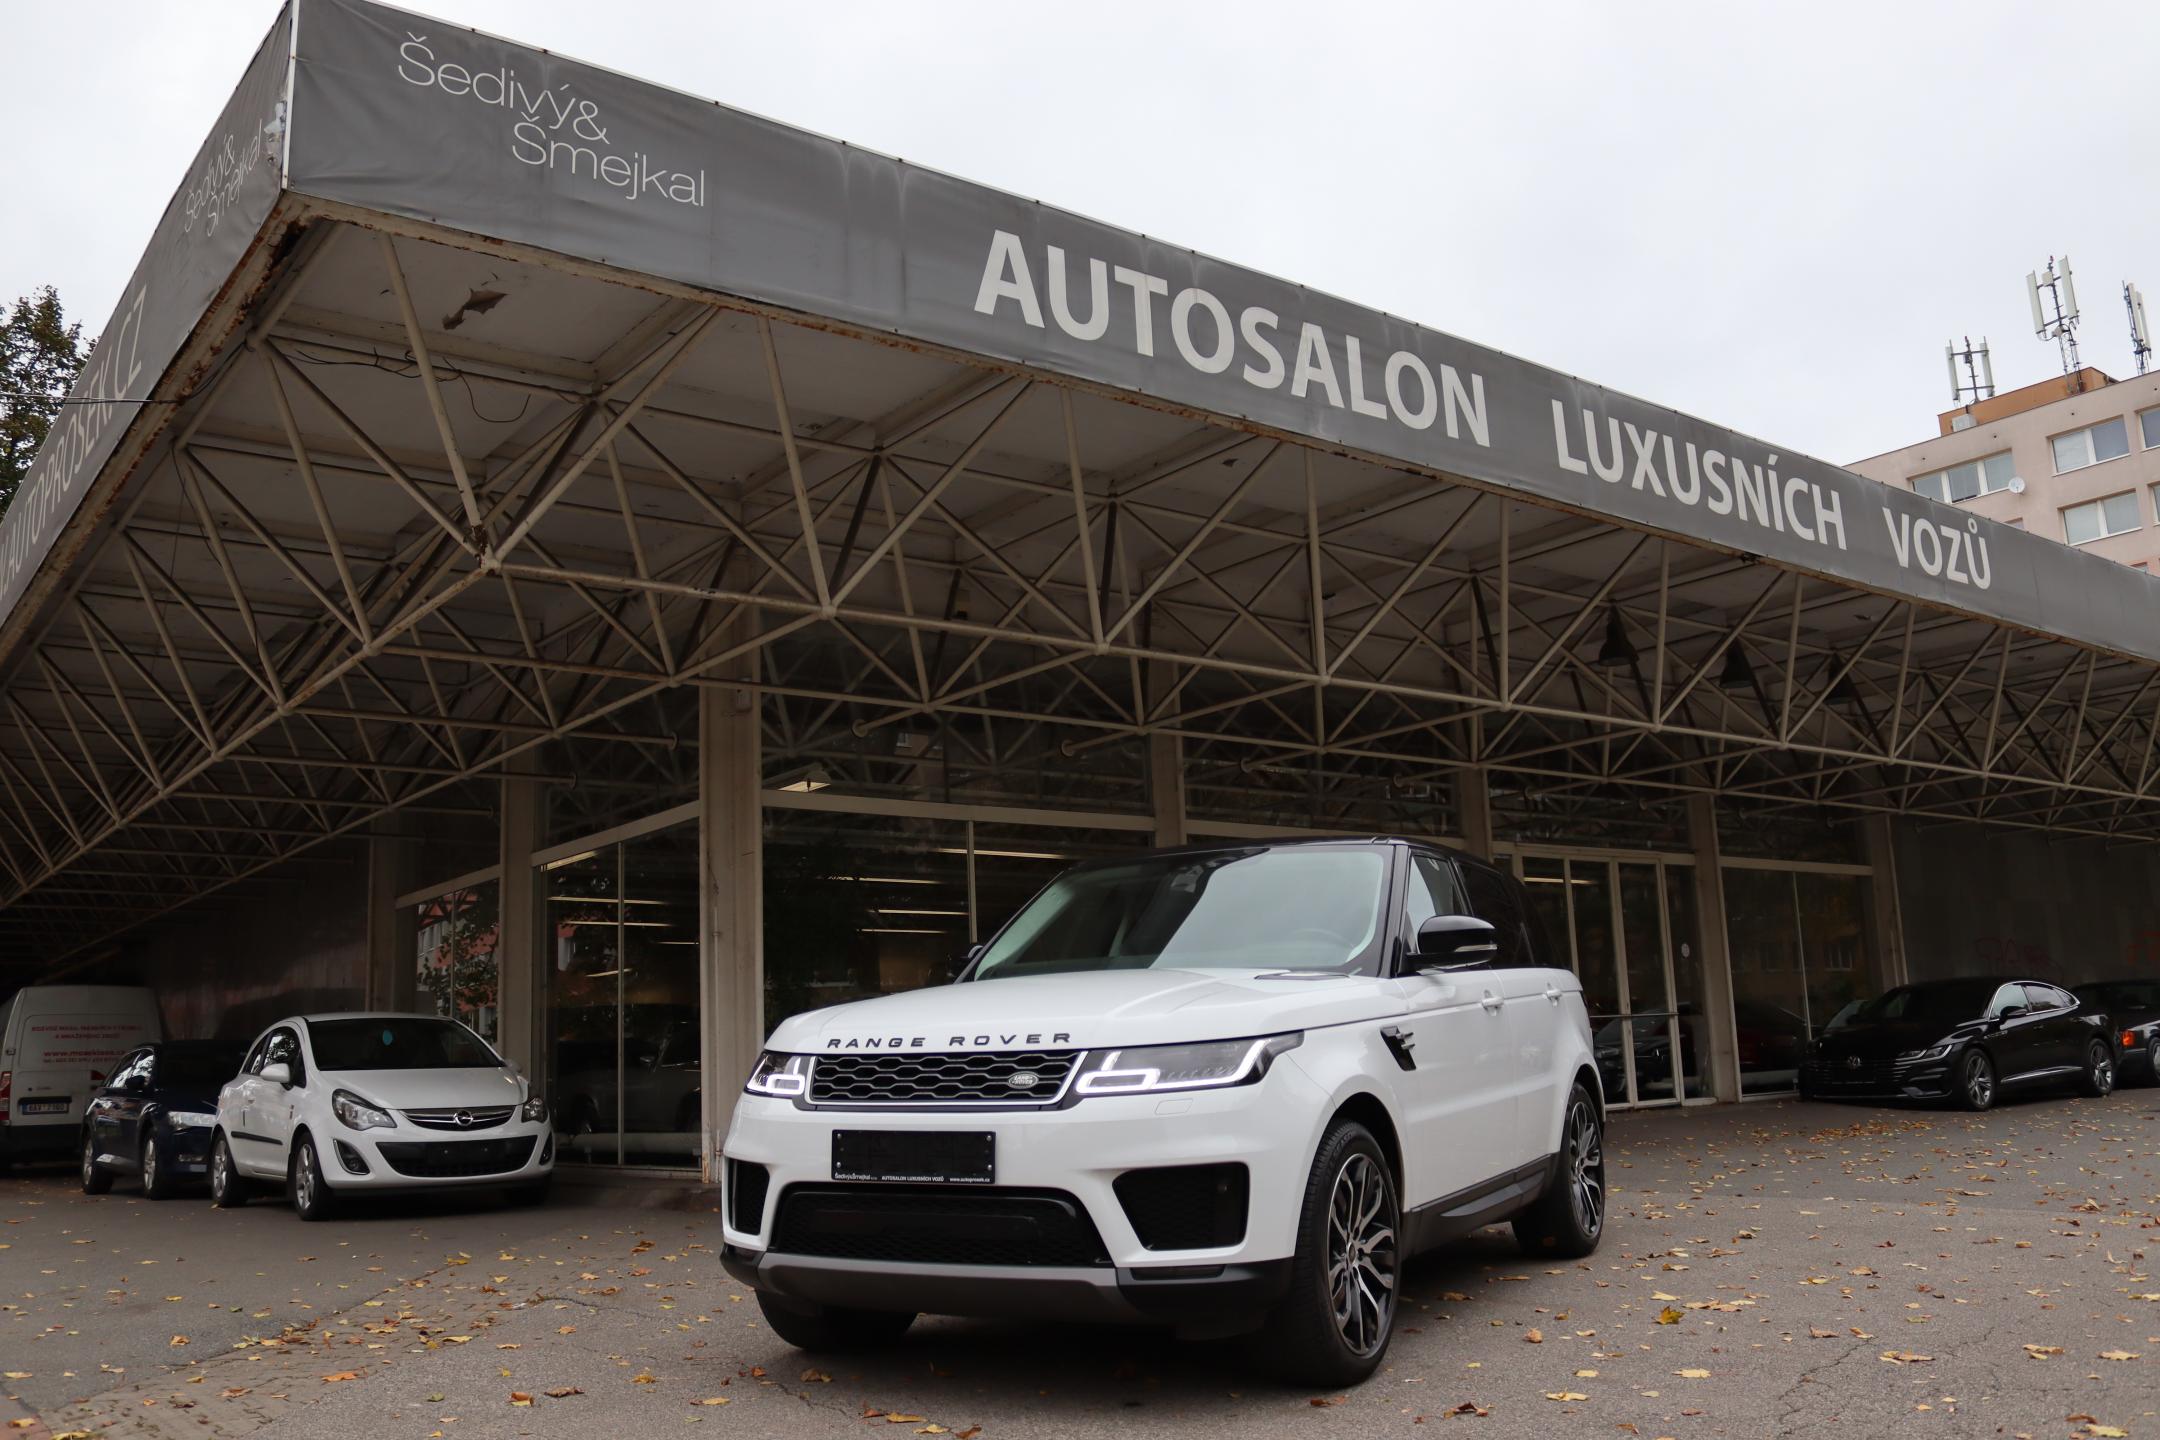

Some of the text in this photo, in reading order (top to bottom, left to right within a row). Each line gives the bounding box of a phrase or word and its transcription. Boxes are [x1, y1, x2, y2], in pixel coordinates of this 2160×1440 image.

[398, 31, 610, 144] Šedivý&
[512, 111, 704, 207] Šmejkal
[974, 229, 1991, 590] AUTOSALON LUXUSNÍCH VOZŮ
[827, 1032, 1071, 1049] RANGE ROVER
